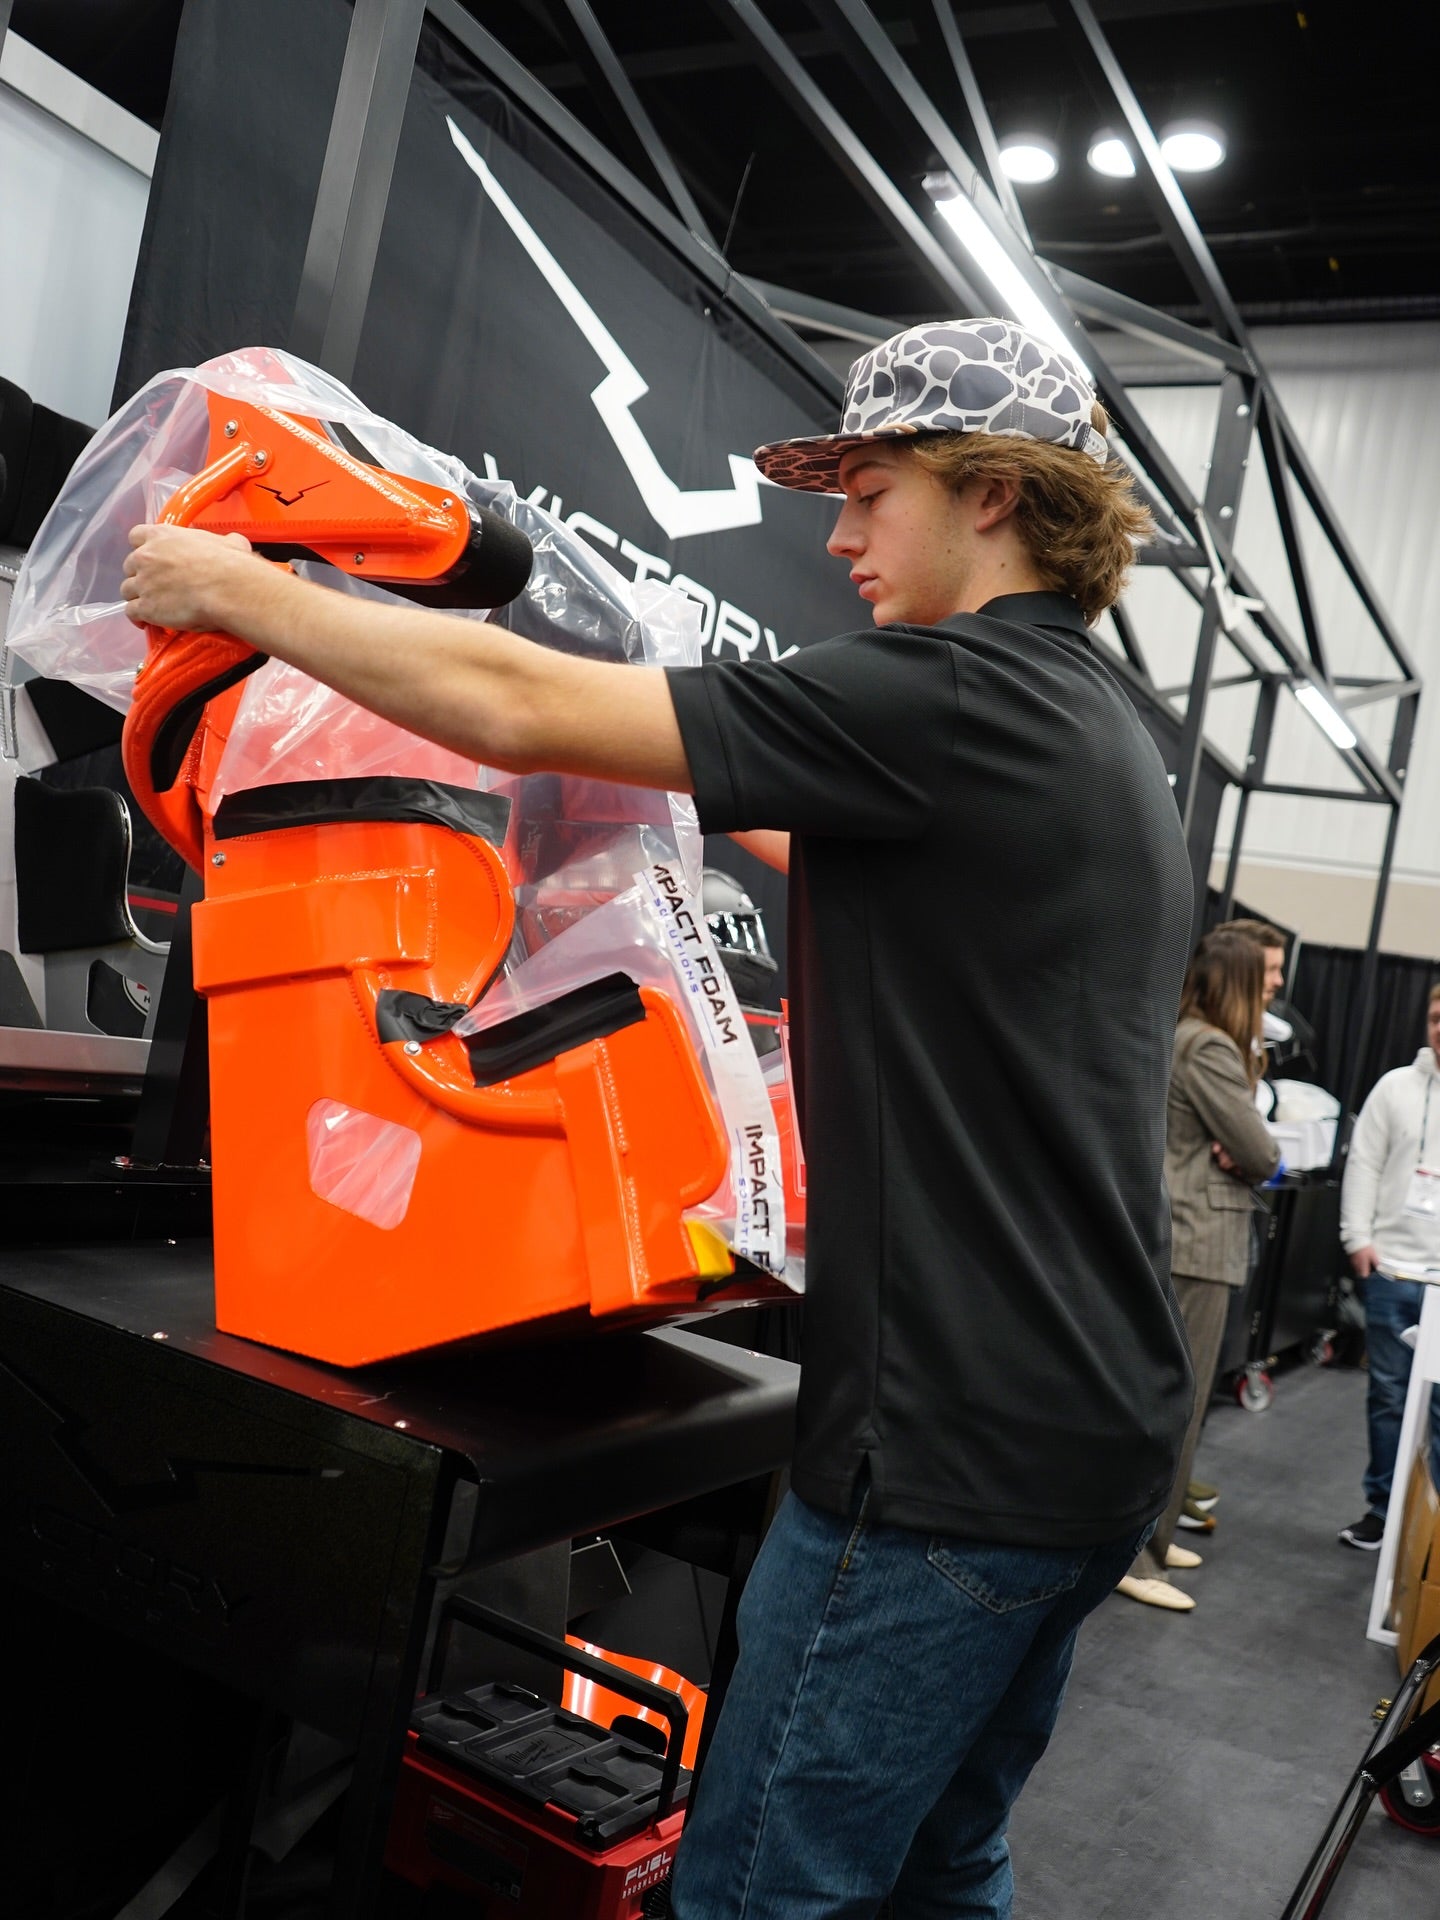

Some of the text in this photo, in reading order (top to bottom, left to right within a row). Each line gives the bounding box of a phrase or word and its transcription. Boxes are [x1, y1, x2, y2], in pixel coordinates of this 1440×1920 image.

[653, 898, 699, 993] SOUTIONS
[696, 957, 738, 1044] FOAM
[739, 1178, 749, 1257] SOLUTIO
[744, 1124, 770, 1237] IMPACT
[622, 1865, 670, 1899] BRUSHLESS
[625, 1851, 671, 1886] FUEL
